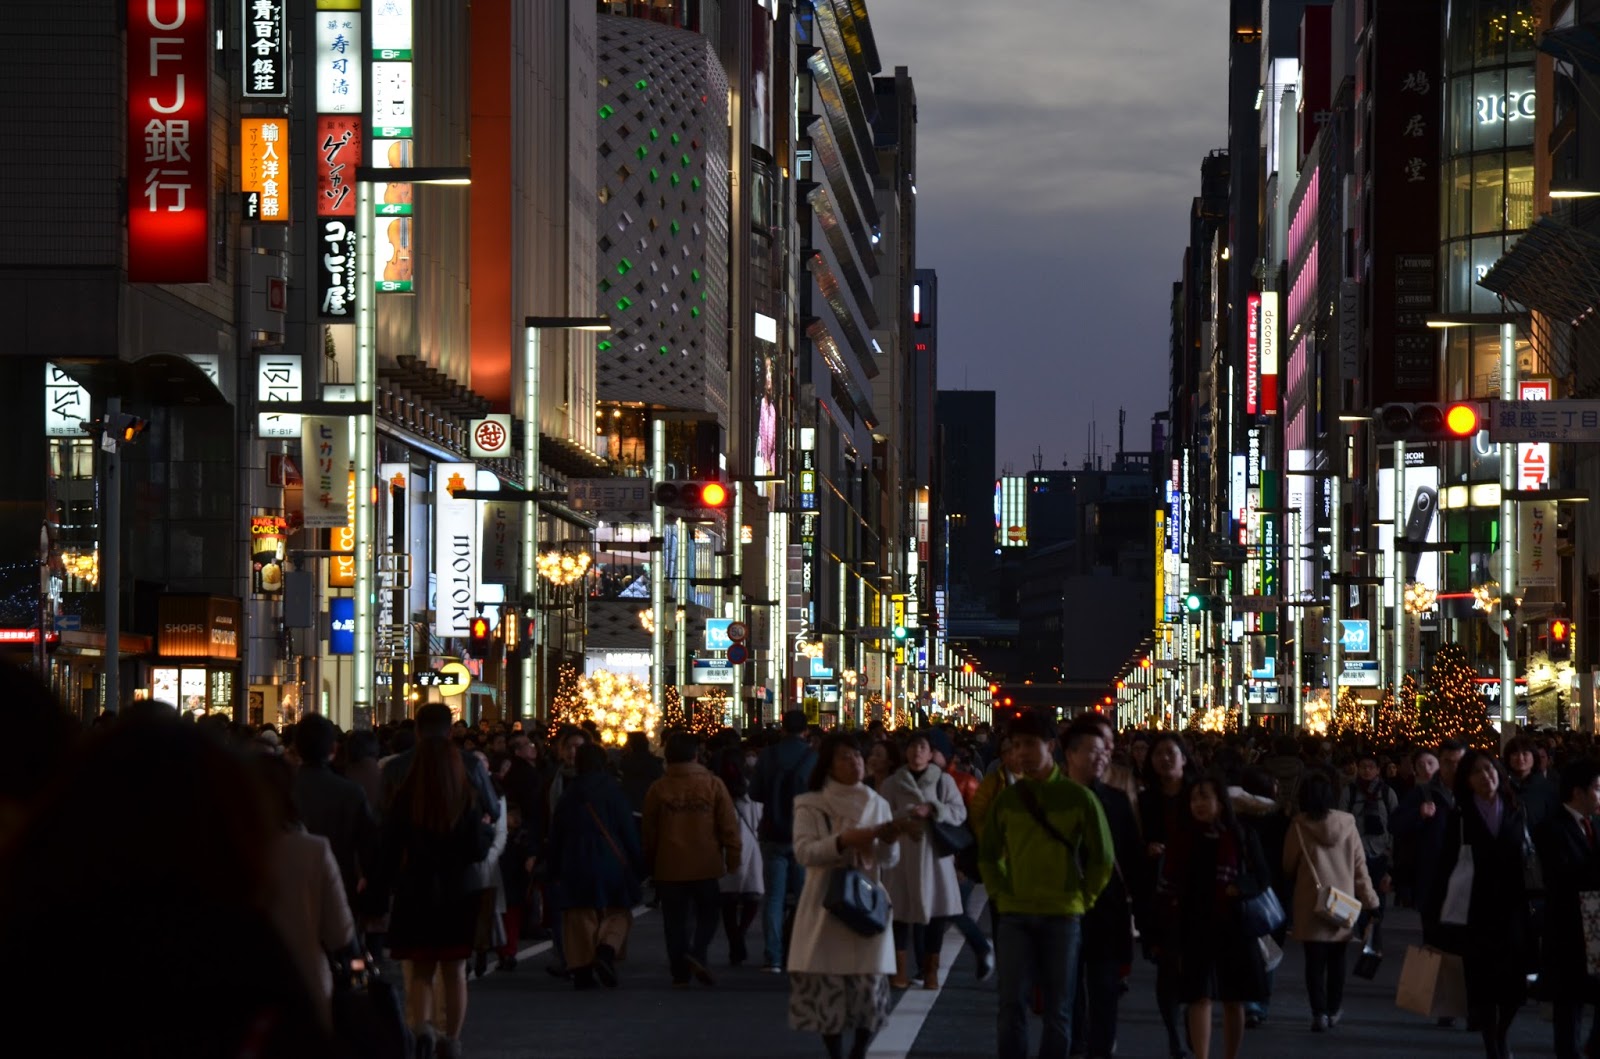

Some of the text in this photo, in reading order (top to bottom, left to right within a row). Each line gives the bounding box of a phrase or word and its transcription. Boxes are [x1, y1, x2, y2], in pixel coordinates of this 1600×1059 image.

[252, 0, 275, 90] 青百合飯荘
[331, 34, 350, 95] 寿司清
[381, 50, 401, 59] 6F
[145, 0, 191, 212] UFJ銀行
[1402, 71, 1428, 182] 鳩居堂
[261, 123, 279, 217] 輸入洋食器
[248, 193, 257, 217] 4F
[382, 204, 402, 213] 4F
[323, 220, 347, 316] コーヒー屋
[382, 281, 402, 290] 3F
[1265, 310, 1274, 355] docomo
[1343, 295, 1357, 367] TASAKI
[1500, 411, 1597, 429] 銀座三丁目
[320, 425, 333, 509] ヒカリミチ
[252, 525, 279, 534] CAKES
[1265, 521, 1273, 571] PRESTIA
[1532, 507, 1543, 572] ヒカリミチ
[452, 535, 471, 632] MOTOKI
[165, 623, 203, 633] SHOPS
[796, 608, 809, 662] FANCL
